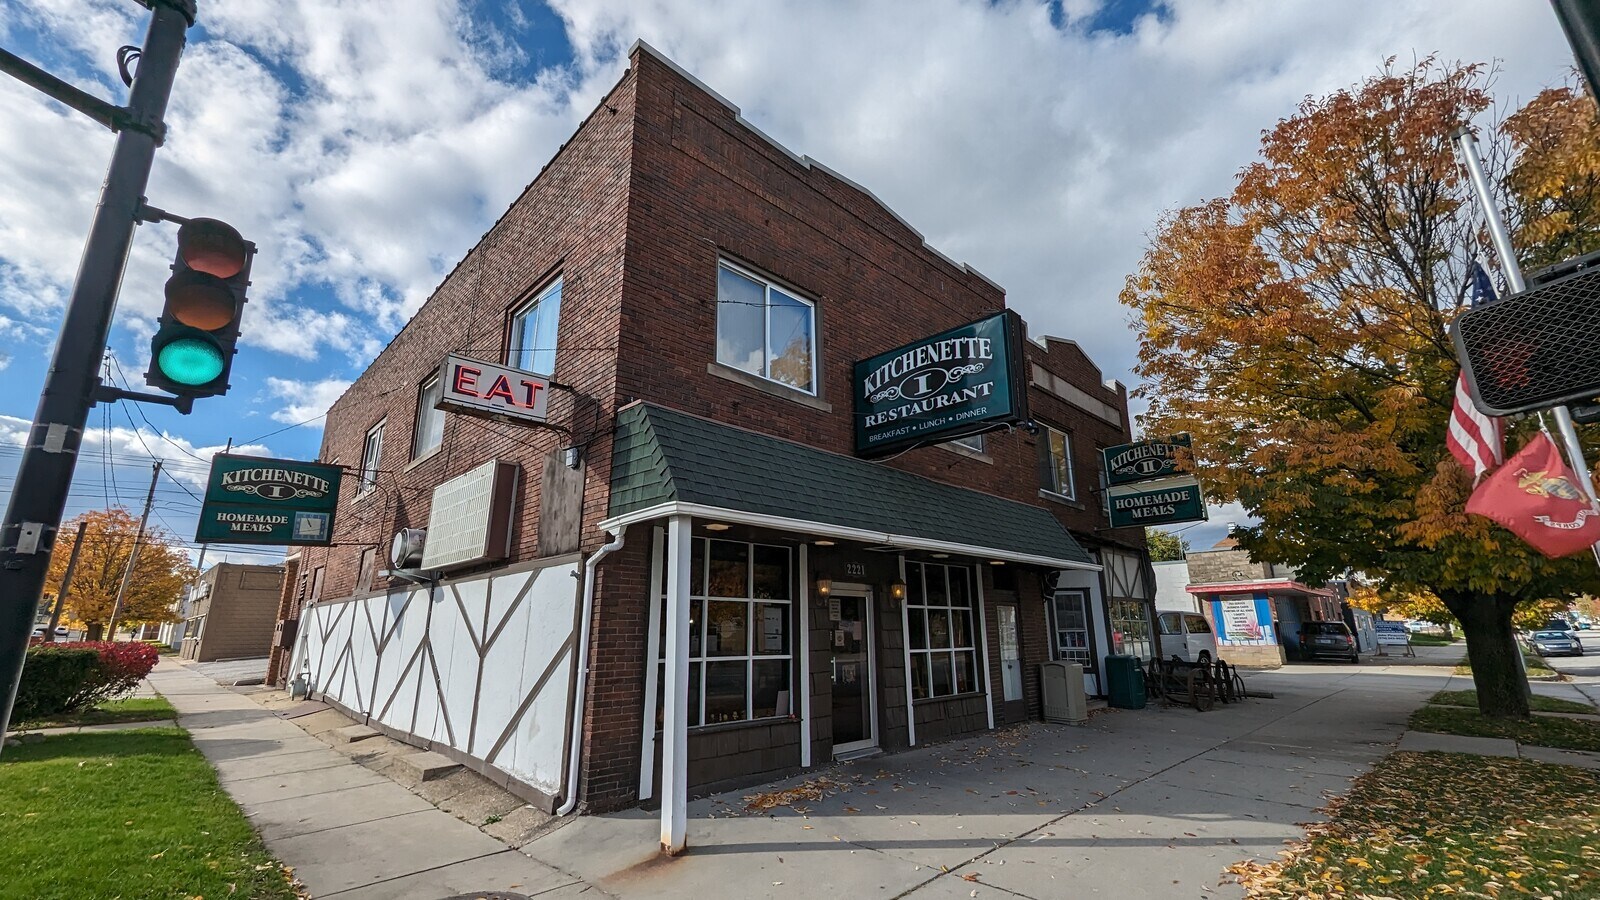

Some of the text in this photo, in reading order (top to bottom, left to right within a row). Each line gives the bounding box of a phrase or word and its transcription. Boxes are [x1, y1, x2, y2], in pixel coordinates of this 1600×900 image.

[863, 337, 993, 399] KITCHENETTE
[452, 364, 544, 410] EAT
[913, 373, 932, 396] I
[864, 382, 994, 428] RESTAURANT
[869, 406, 988, 443] BREAKFAST LUNCH DINNER
[1110, 443, 1189, 472] KITCHENETT
[221, 468, 330, 494] KITCHENETTE
[267, 485, 285, 498] I
[1115, 490, 1190, 510] HOMEMADE
[1131, 504, 1176, 519] MEALS
[216, 512, 289, 524] HOMEMADE
[230, 522, 273, 533] MEALS
[846, 563, 866, 576] 2221
